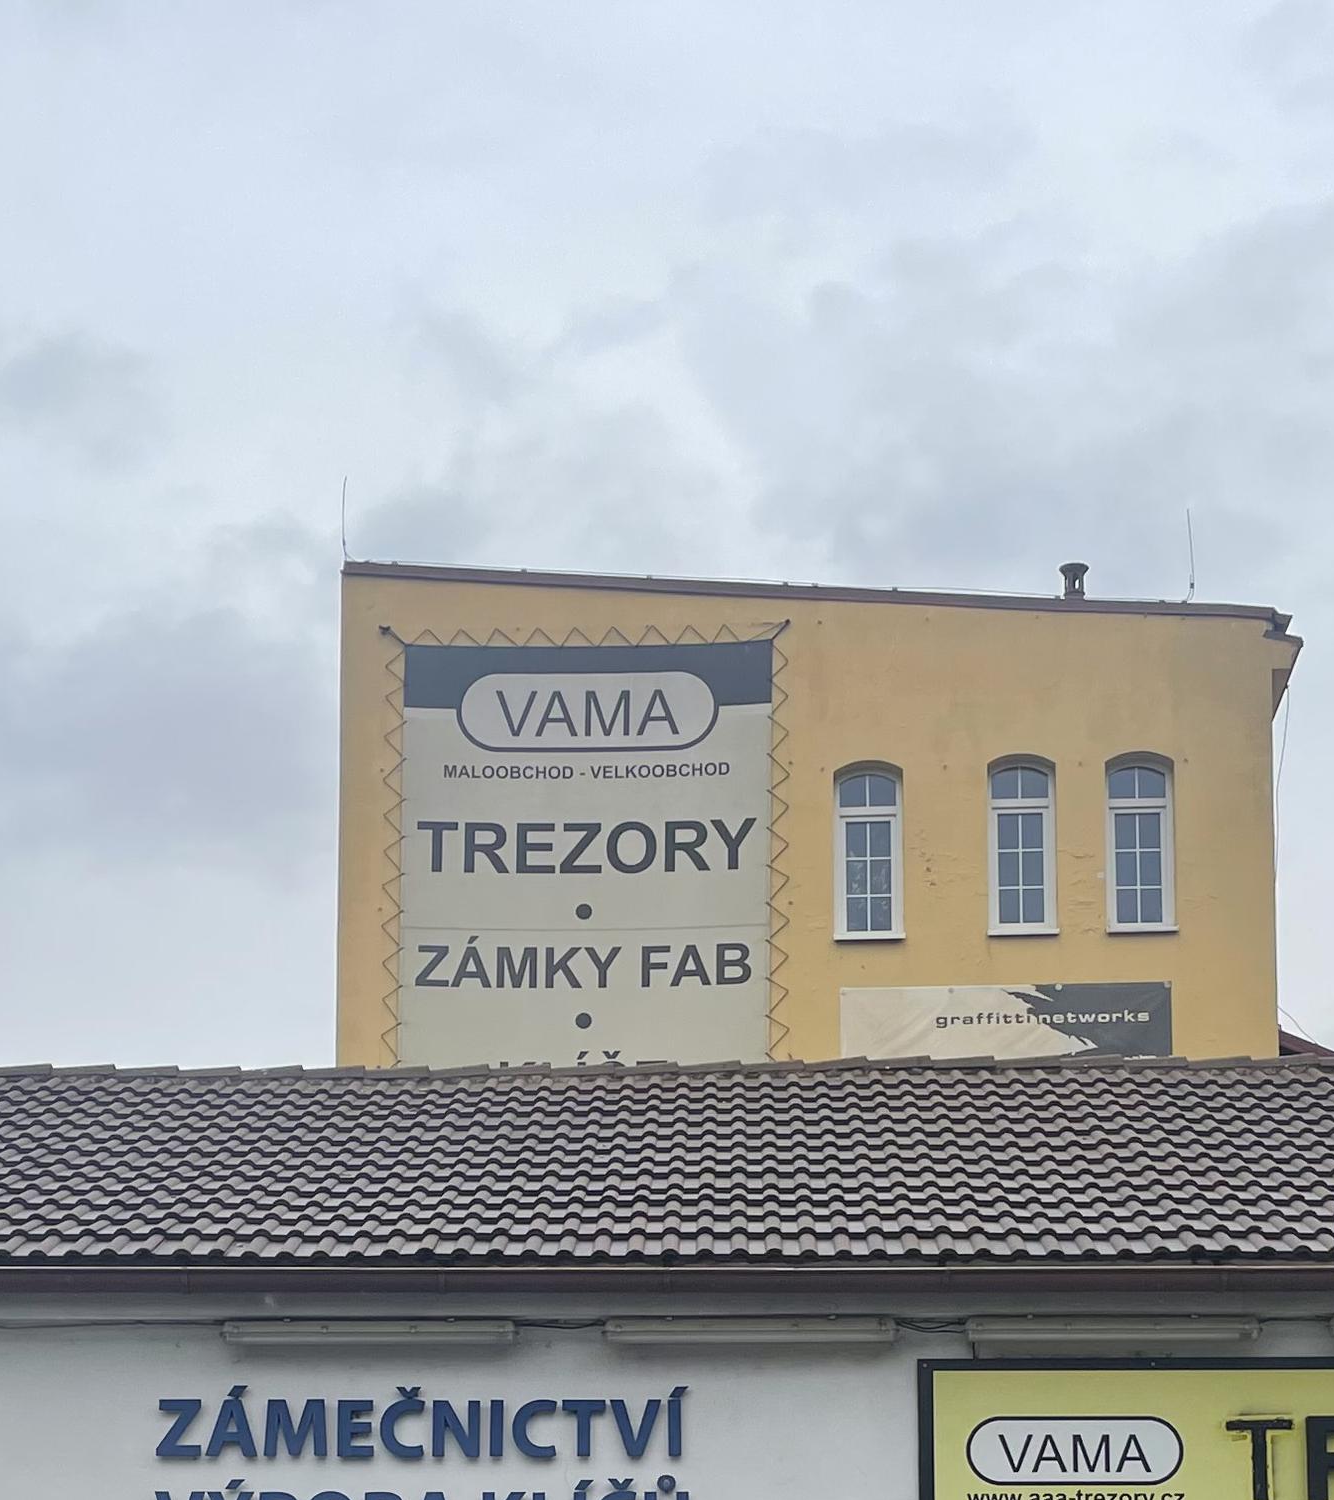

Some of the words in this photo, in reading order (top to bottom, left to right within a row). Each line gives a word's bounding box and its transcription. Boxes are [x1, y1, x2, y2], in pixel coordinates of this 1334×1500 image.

[496, 688, 680, 737] VAMA
[443, 763, 575, 780] MALOOBCHOD
[590, 761, 731, 780] VELKOOBCHOD
[416, 817, 758, 875] TREZORY
[414, 935, 622, 989] ZÁMKY
[641, 941, 753, 987] FAB
[156, 1385, 690, 1459] ZÁMEČNICTVÍ
[997, 1433, 1153, 1473] VAMA
